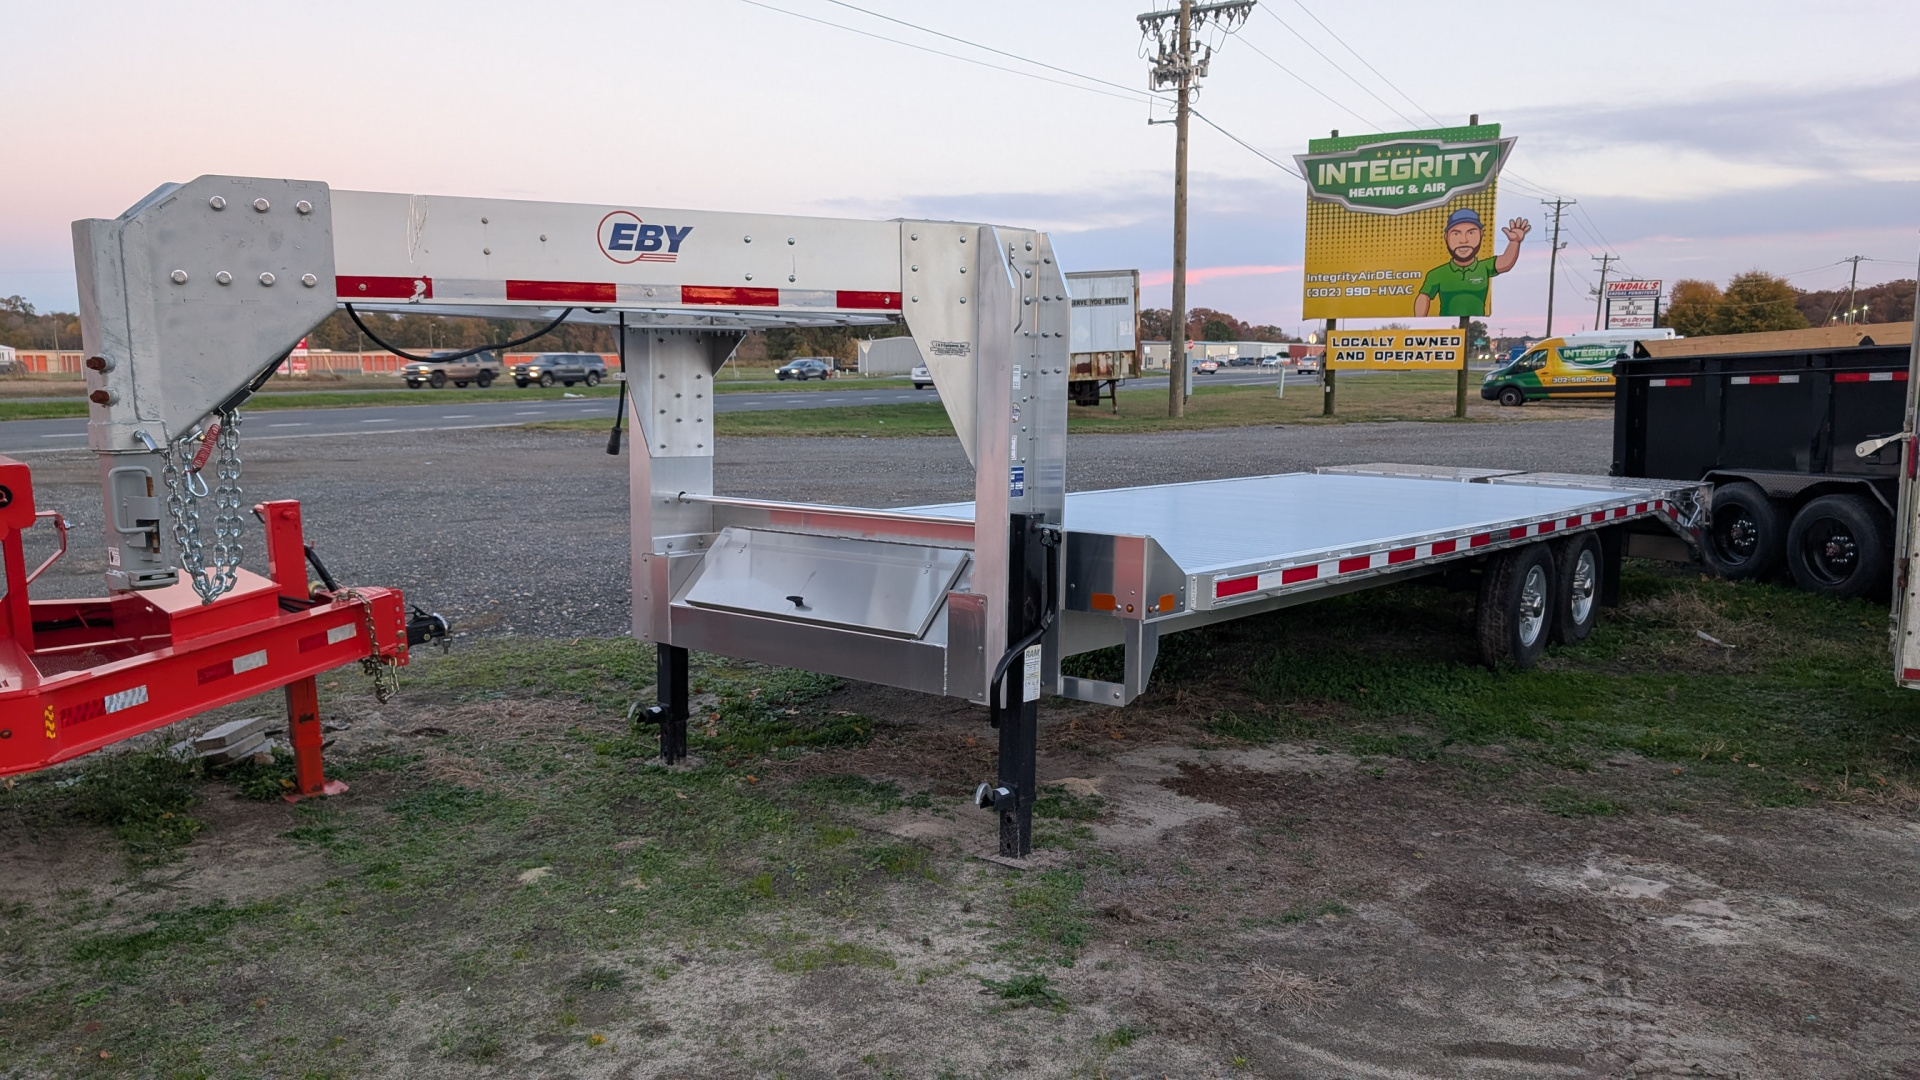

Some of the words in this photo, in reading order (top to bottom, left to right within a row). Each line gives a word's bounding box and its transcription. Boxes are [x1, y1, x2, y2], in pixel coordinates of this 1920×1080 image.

[1318, 151, 1490, 186] INTEGRITY
[1349, 184, 1404, 198] HEATING
[1408, 184, 1419, 194] &
[1423, 182, 1446, 193] AIR
[608, 222, 694, 253] EBY
[1306, 270, 1422, 283] IntegrityAirDE.com
[1306, 287, 1342, 297] (302)
[1345, 285, 1414, 296] 990-HVAC
[1608, 281, 1659, 290] TYNDALL'S
[1104, 297, 1126, 305] BETTER
[1332, 337, 1395, 347] LOCALLY
[1404, 336, 1461, 348] OWNED
[1336, 351, 1365, 361] AND
[1374, 351, 1455, 363] OPERATED
[1563, 347, 1621, 358] INTEGRITY
[1025, 648, 1040, 659] RAM
